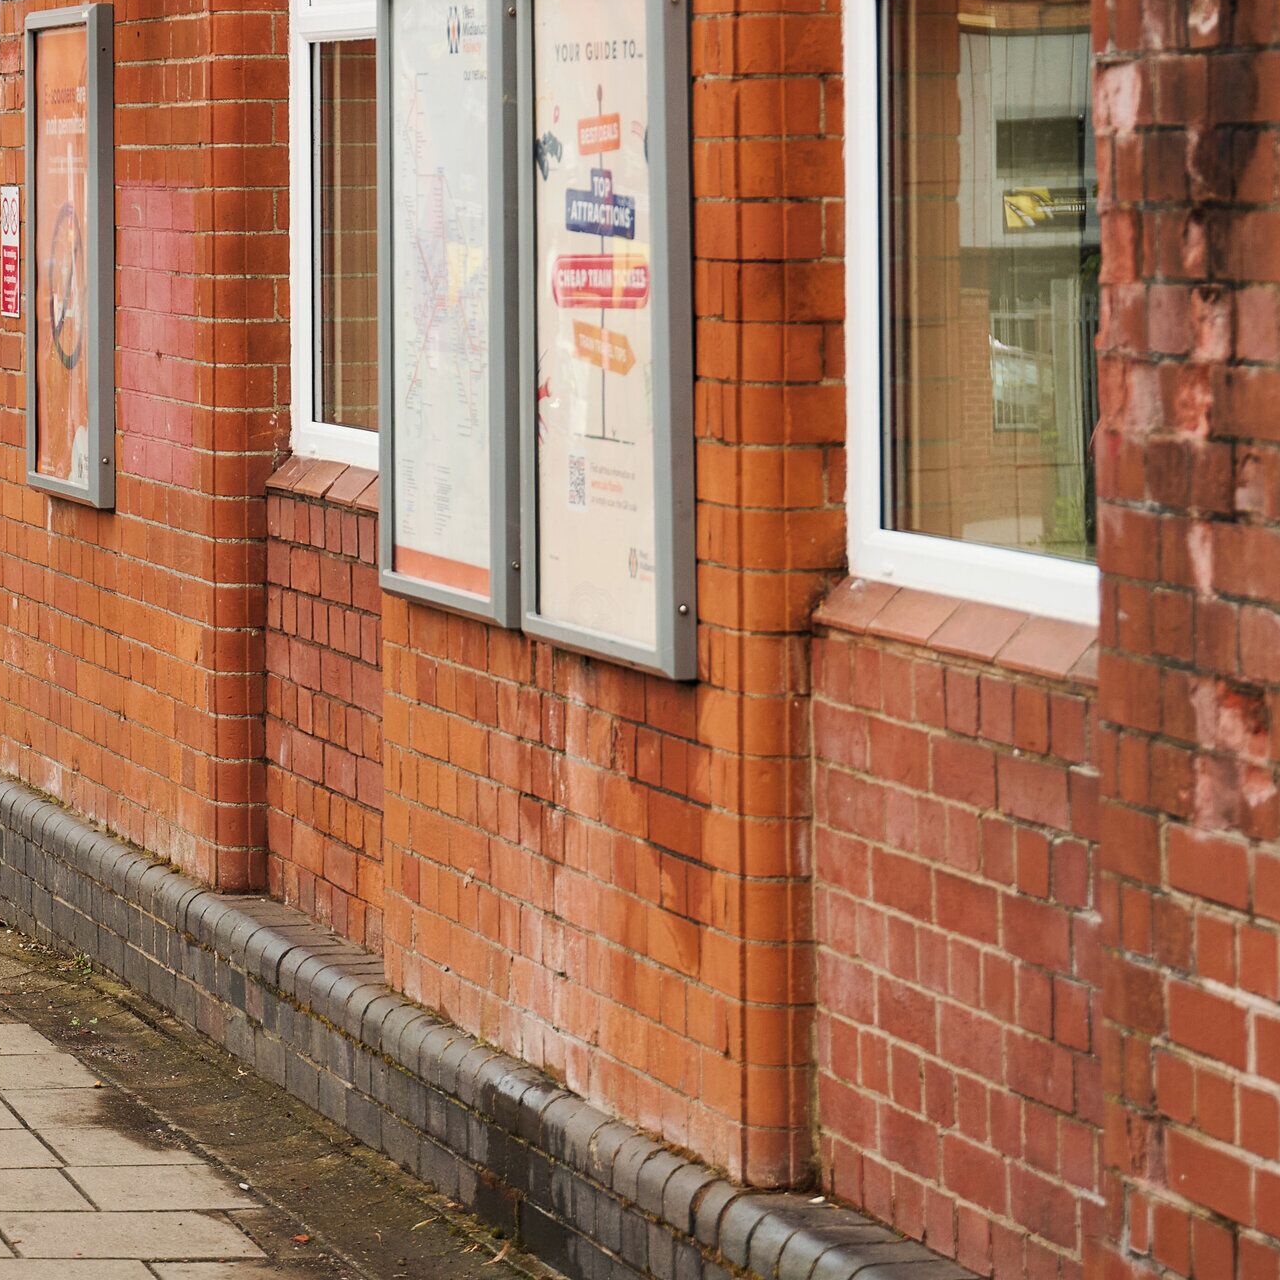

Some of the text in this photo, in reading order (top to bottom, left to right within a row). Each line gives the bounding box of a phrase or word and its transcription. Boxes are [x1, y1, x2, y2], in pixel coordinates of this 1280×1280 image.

[555, 43, 580, 62] YOUR
[585, 41, 617, 61] GUIDE
[593, 177, 611, 198] TOP
[570, 200, 631, 228] ATTRACTIONS
[557, 269, 587, 288] CHEAP
[587, 268, 612, 288] TRAIN
